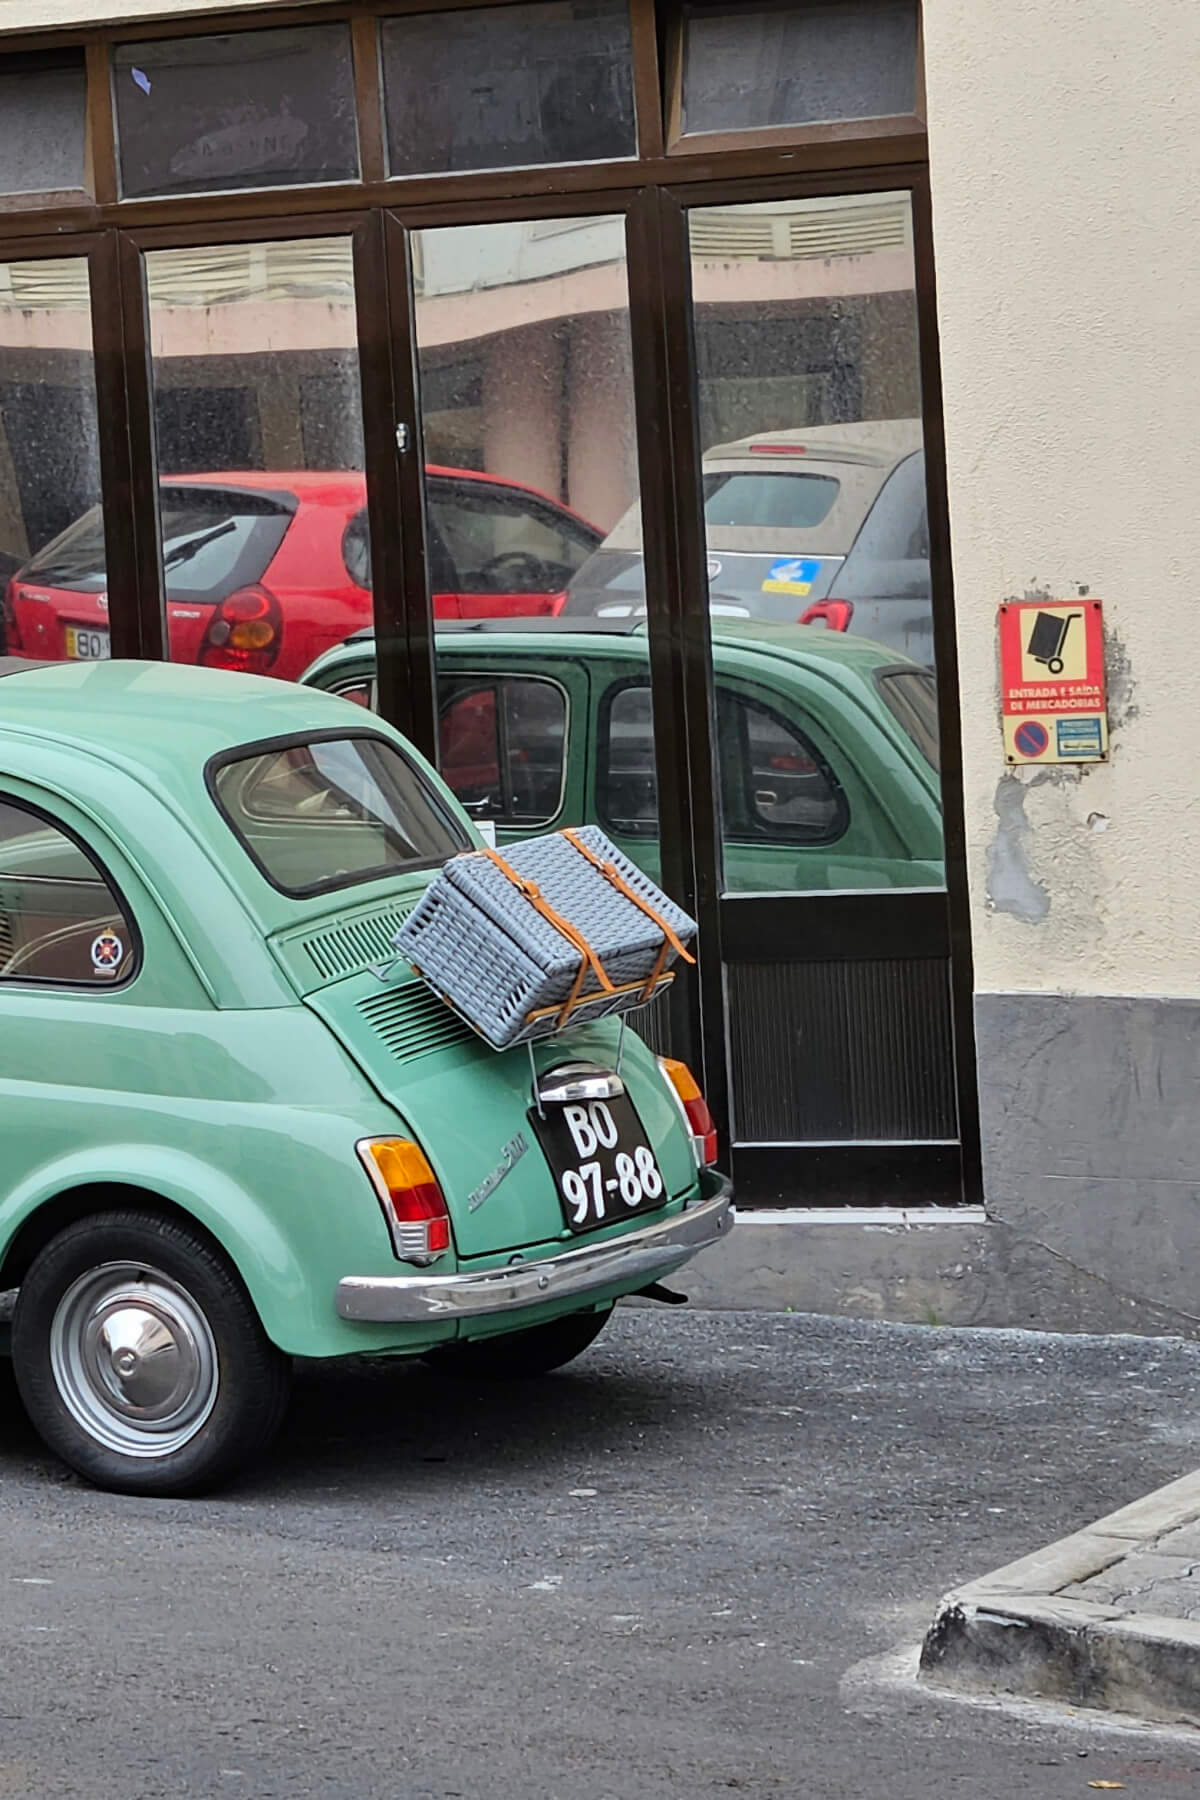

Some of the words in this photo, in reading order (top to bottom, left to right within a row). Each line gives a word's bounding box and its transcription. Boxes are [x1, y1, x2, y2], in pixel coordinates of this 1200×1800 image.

[1008, 688, 1058, 699] ENTRADA
[1010, 700, 1024, 711] DE
[1025, 698, 1101, 710] MERCADORIAS
[562, 1101, 618, 1159] BO
[561, 1146, 663, 1224] 97-88
